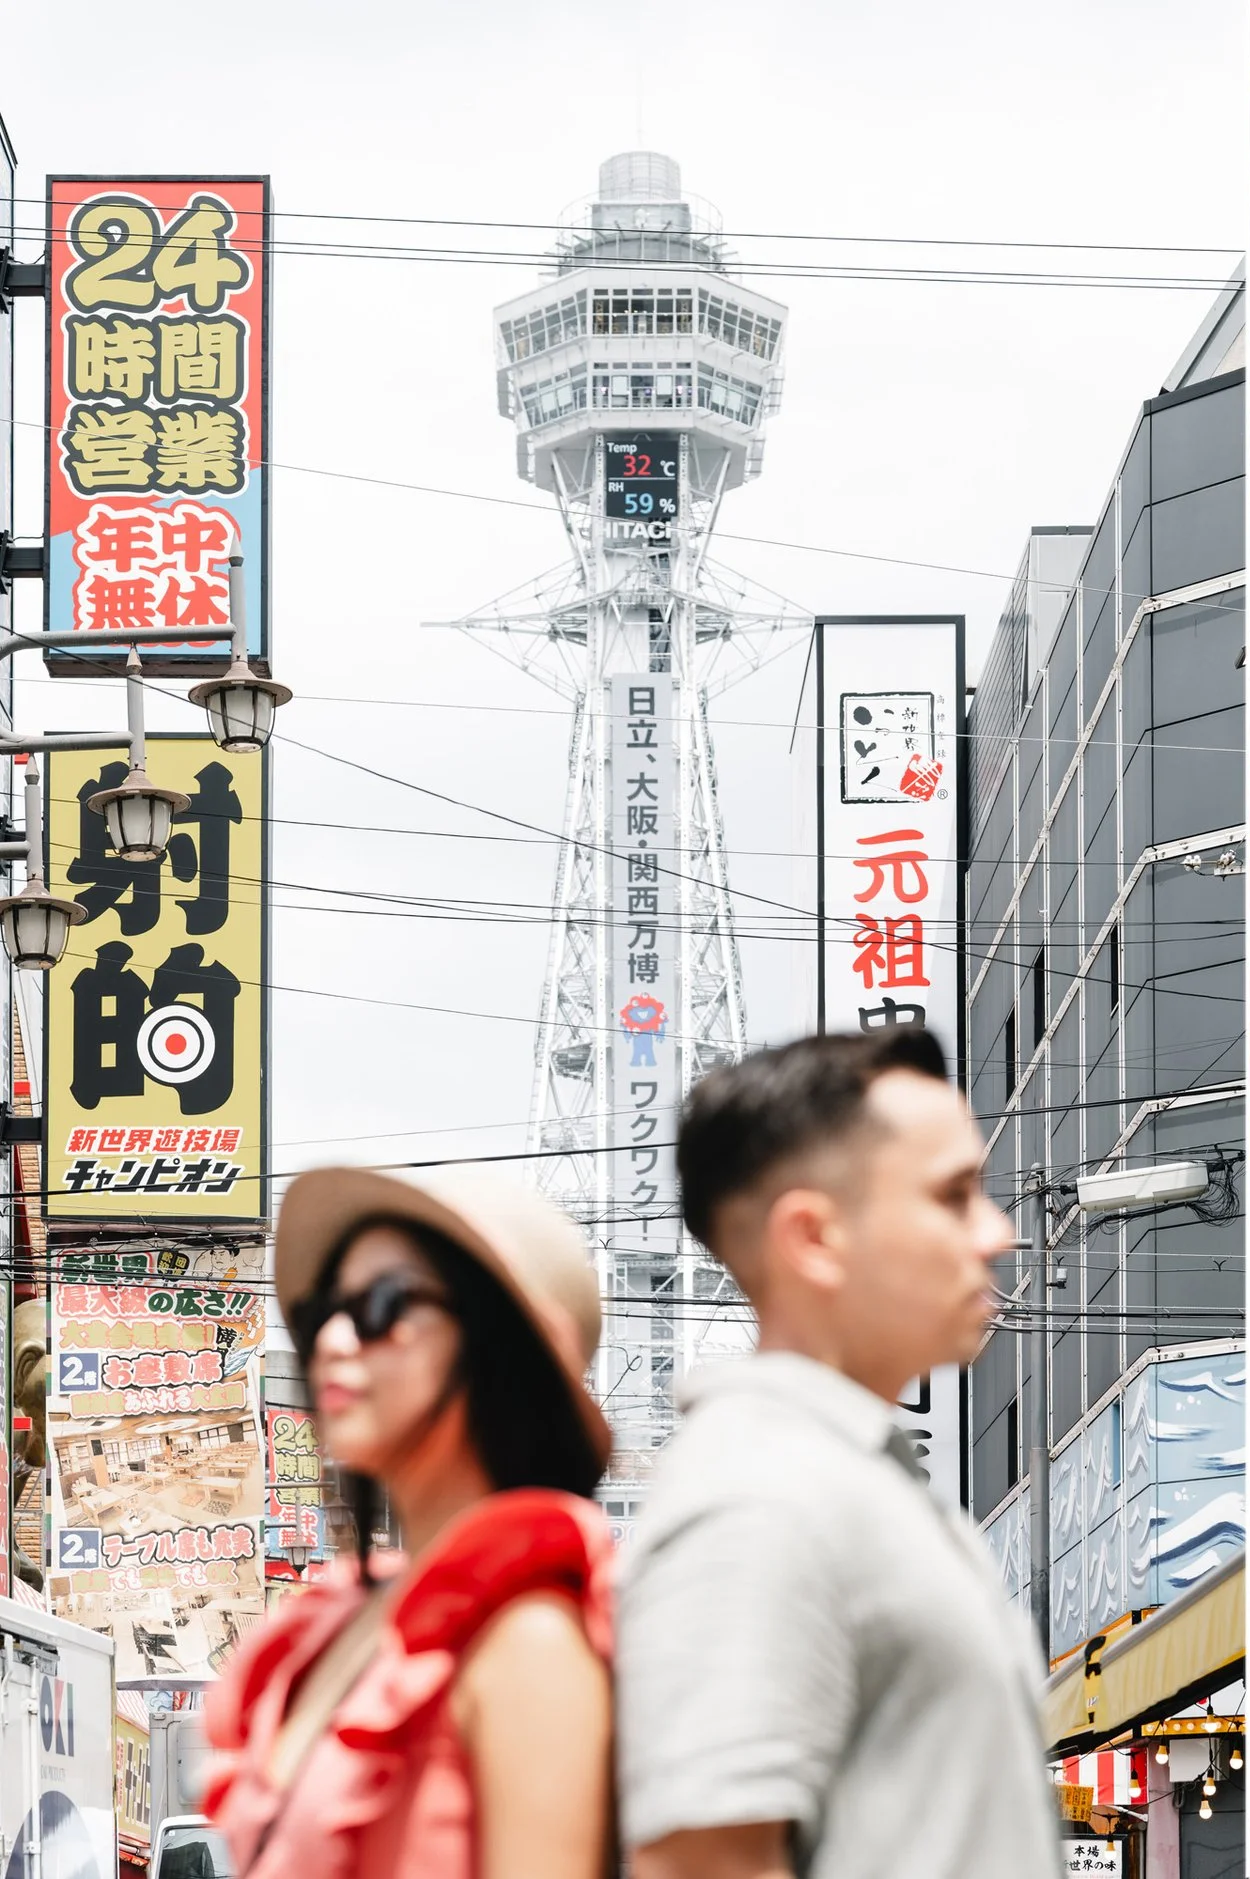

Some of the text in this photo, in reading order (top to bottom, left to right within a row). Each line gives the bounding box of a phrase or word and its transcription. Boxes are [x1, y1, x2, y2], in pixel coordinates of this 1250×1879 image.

[68, 195, 250, 314] 24
[69, 317, 244, 402] 時間
[68, 406, 243, 491] 営業
[607, 442, 637, 454] Temp
[623, 454, 676, 477] 32 °C
[608, 482, 624, 492] RH
[624, 493, 676, 514] 59 %
[86, 511, 230, 573] 年中
[86, 574, 231, 628] 無休
[626, 686, 660, 985] 日立、大阪・関西万博
[67, 761, 243, 1116] 射的
[68, 1127, 241, 1154] 新世界遊技場
[65, 1157, 242, 1196] チャンピオン
[60, 1285, 252, 1317] 最大級の広さ!!
[62, 1353, 222, 1388] 2階 お座敷席
[273, 1416, 320, 1454] 24
[276, 1452, 321, 1481] 時間
[62, 1526, 254, 1566] 2階 テーブル席も充実
[39, 1675, 75, 1757] OKI
[1074, 1845, 1099, 1858] 本場
